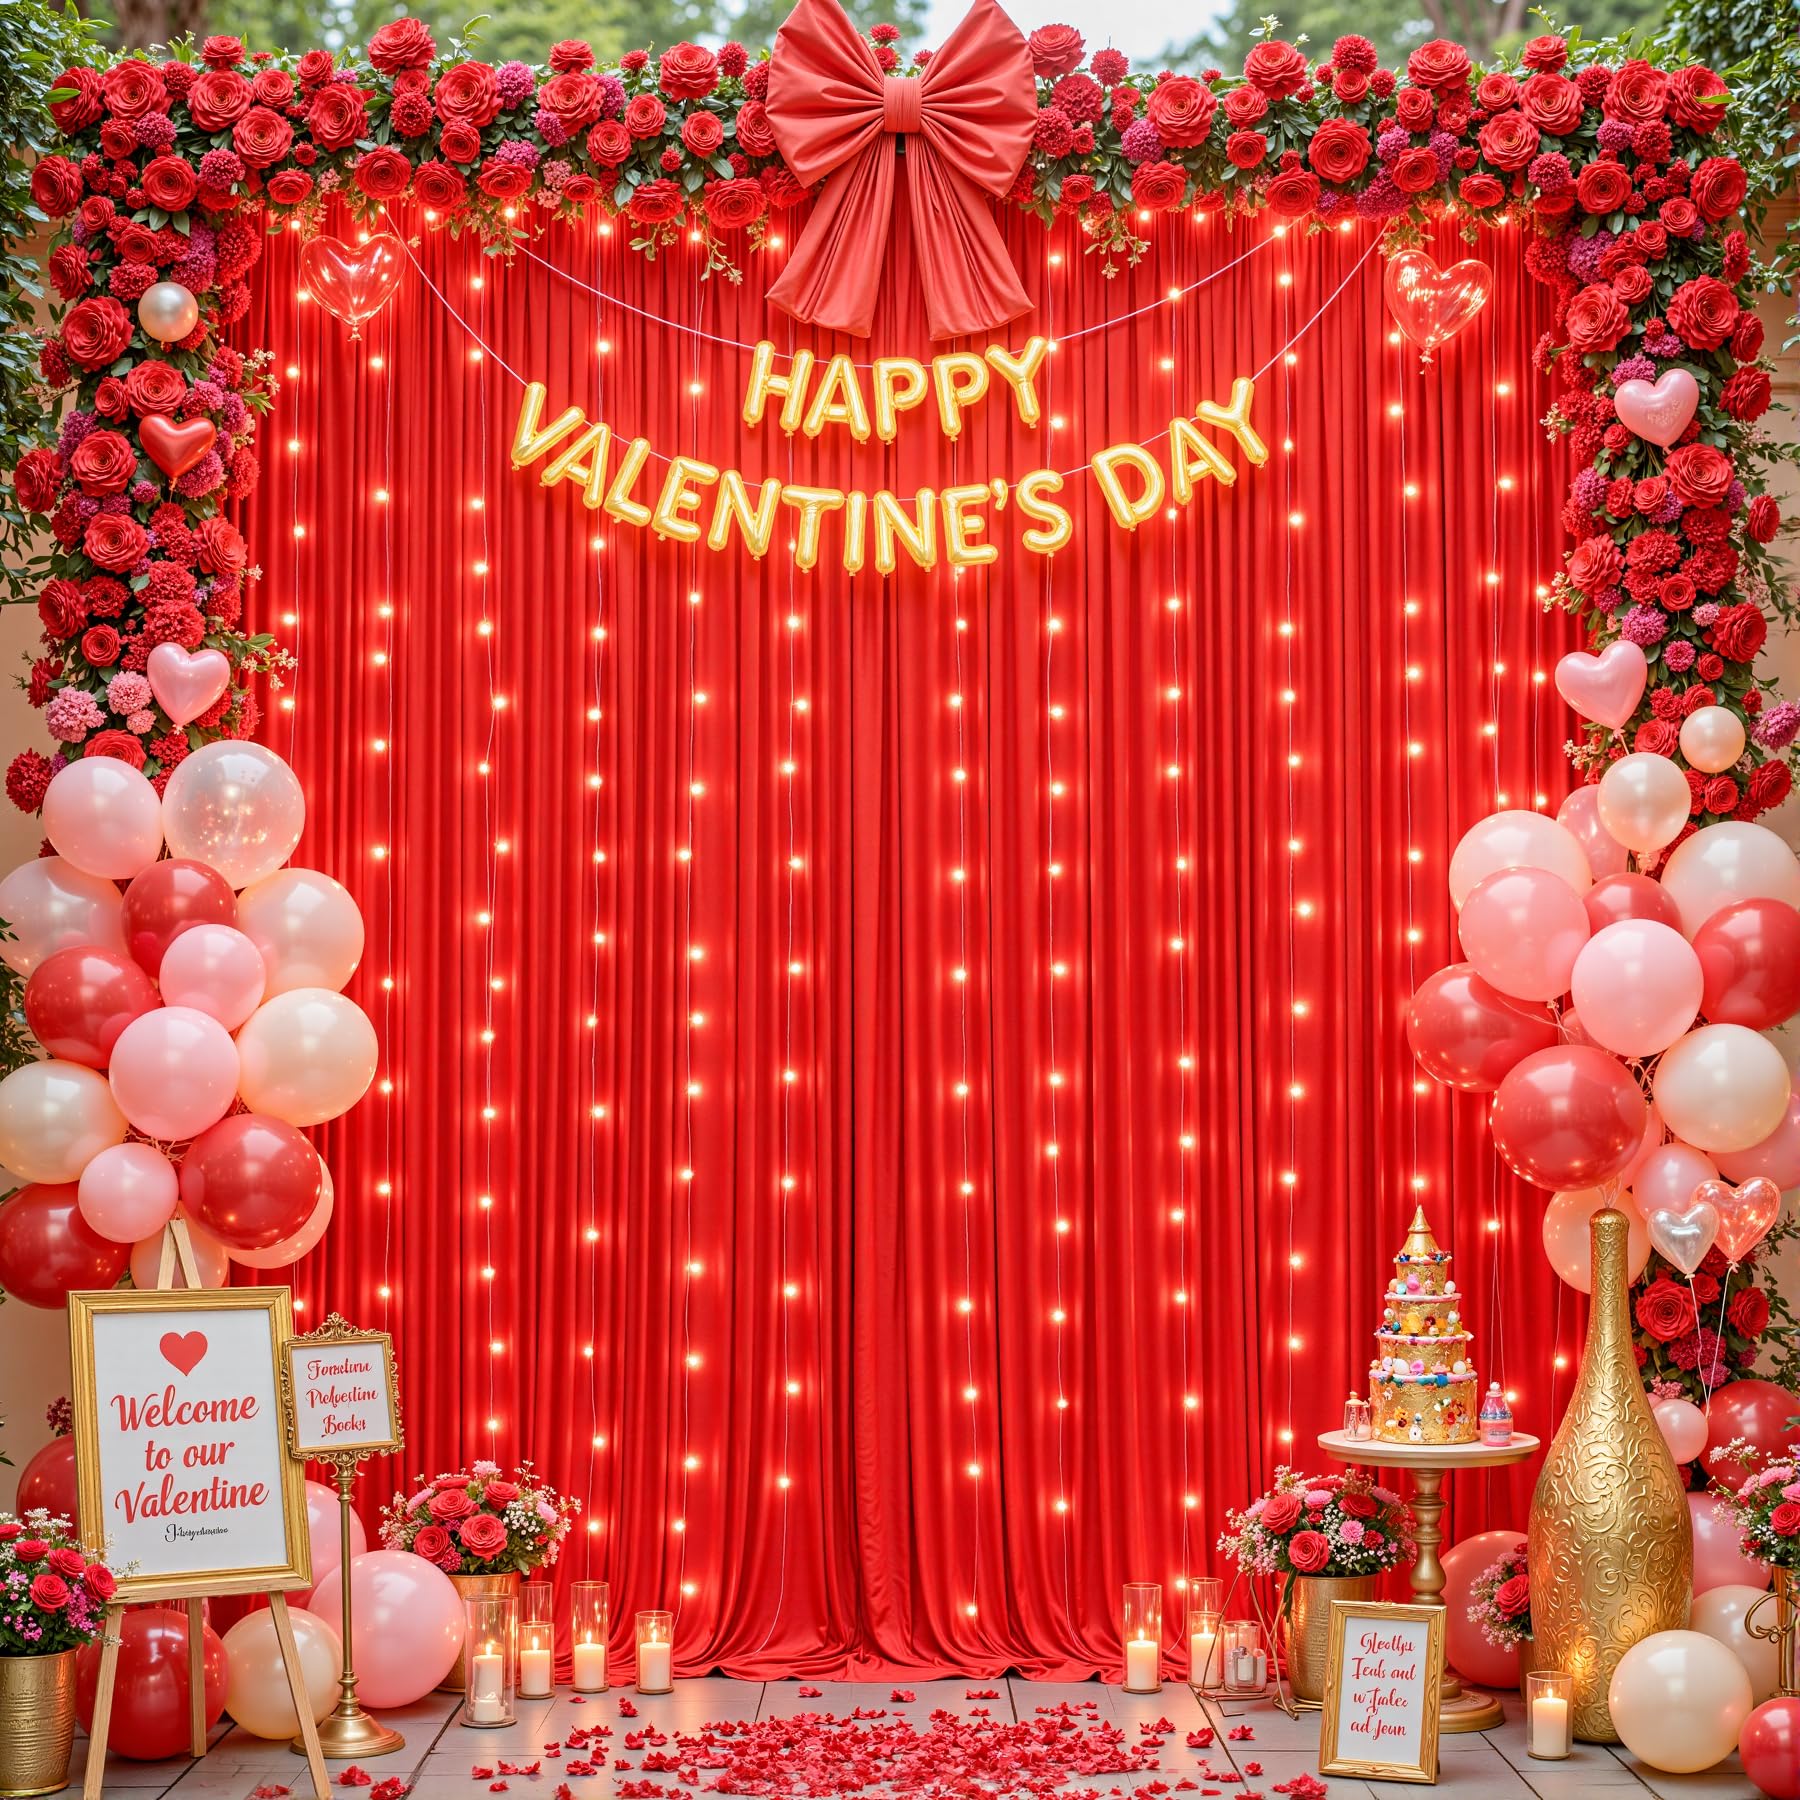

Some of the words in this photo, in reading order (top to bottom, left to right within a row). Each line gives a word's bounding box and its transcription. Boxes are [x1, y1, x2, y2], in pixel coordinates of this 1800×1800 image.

[742, 336, 1048, 442] HAPPY
[1091, 377, 1269, 531] DAY
[110, 1384, 260, 1432] Welcome
[145, 1440, 174, 1472] to
[183, 1441, 235, 1468] our
[114, 1473, 270, 1524] Valentine
